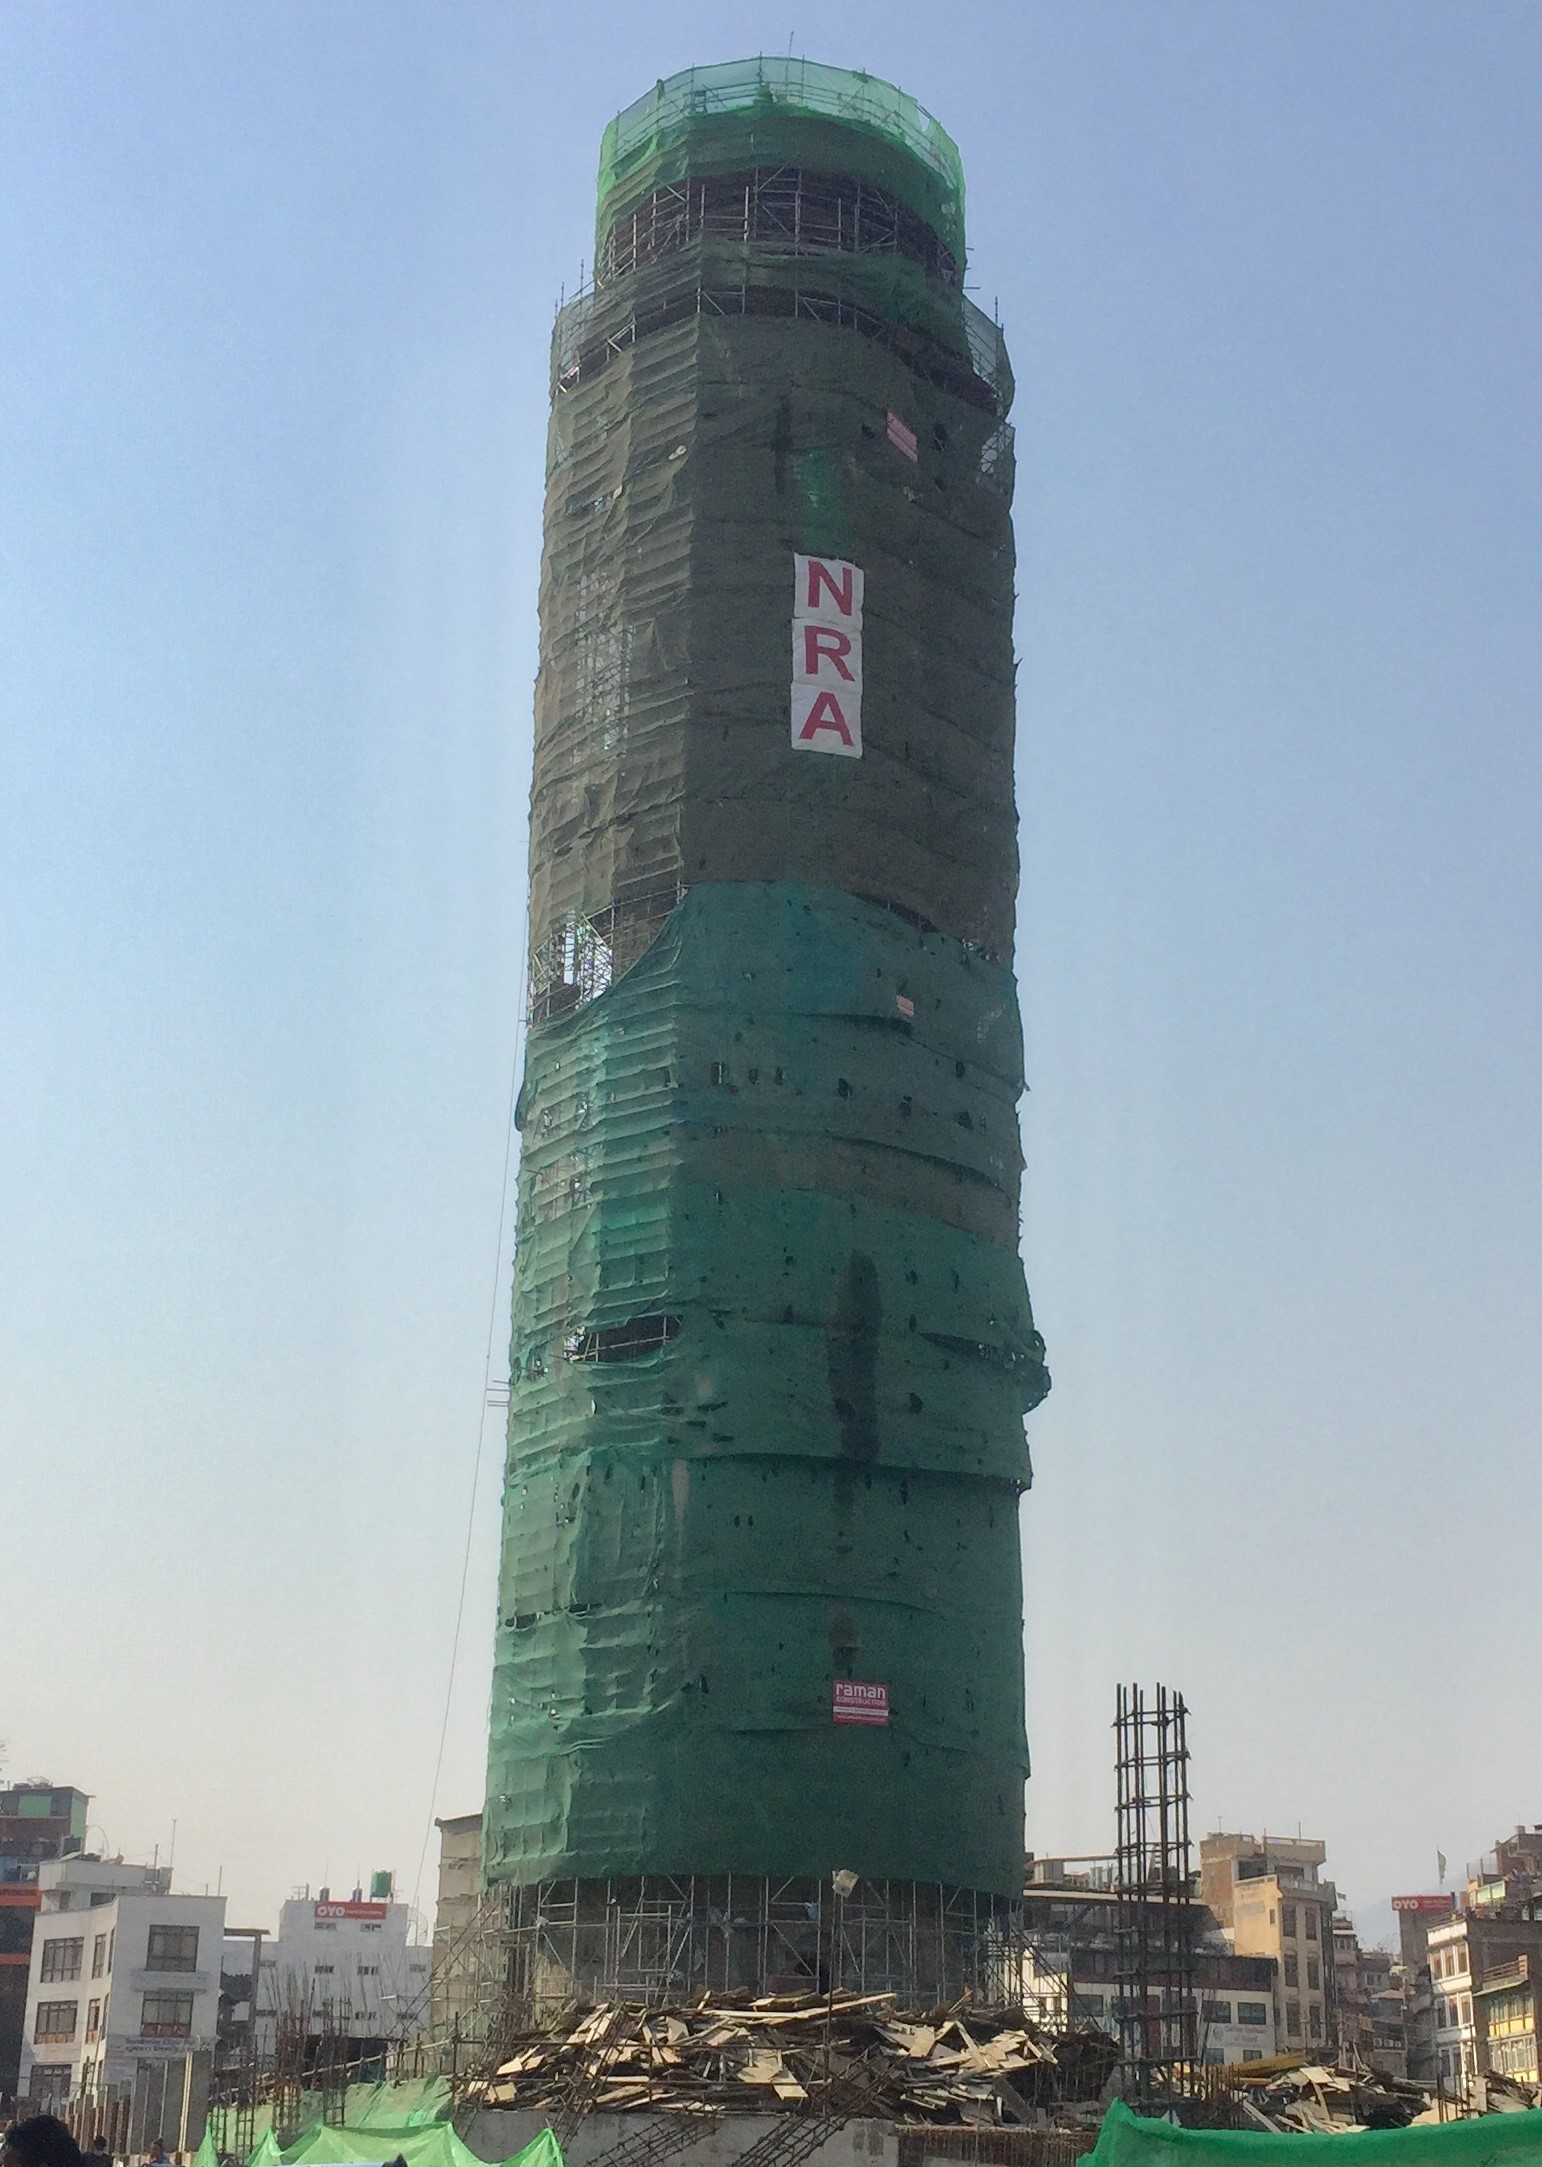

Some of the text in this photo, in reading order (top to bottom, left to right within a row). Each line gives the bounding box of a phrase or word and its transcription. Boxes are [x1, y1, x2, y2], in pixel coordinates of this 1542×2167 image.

[799, 560, 856, 747] NRA
[836, 1683, 886, 1699] raman
[317, 1905, 346, 1917] OYO
[1392, 1899, 1419, 1910] OYO
